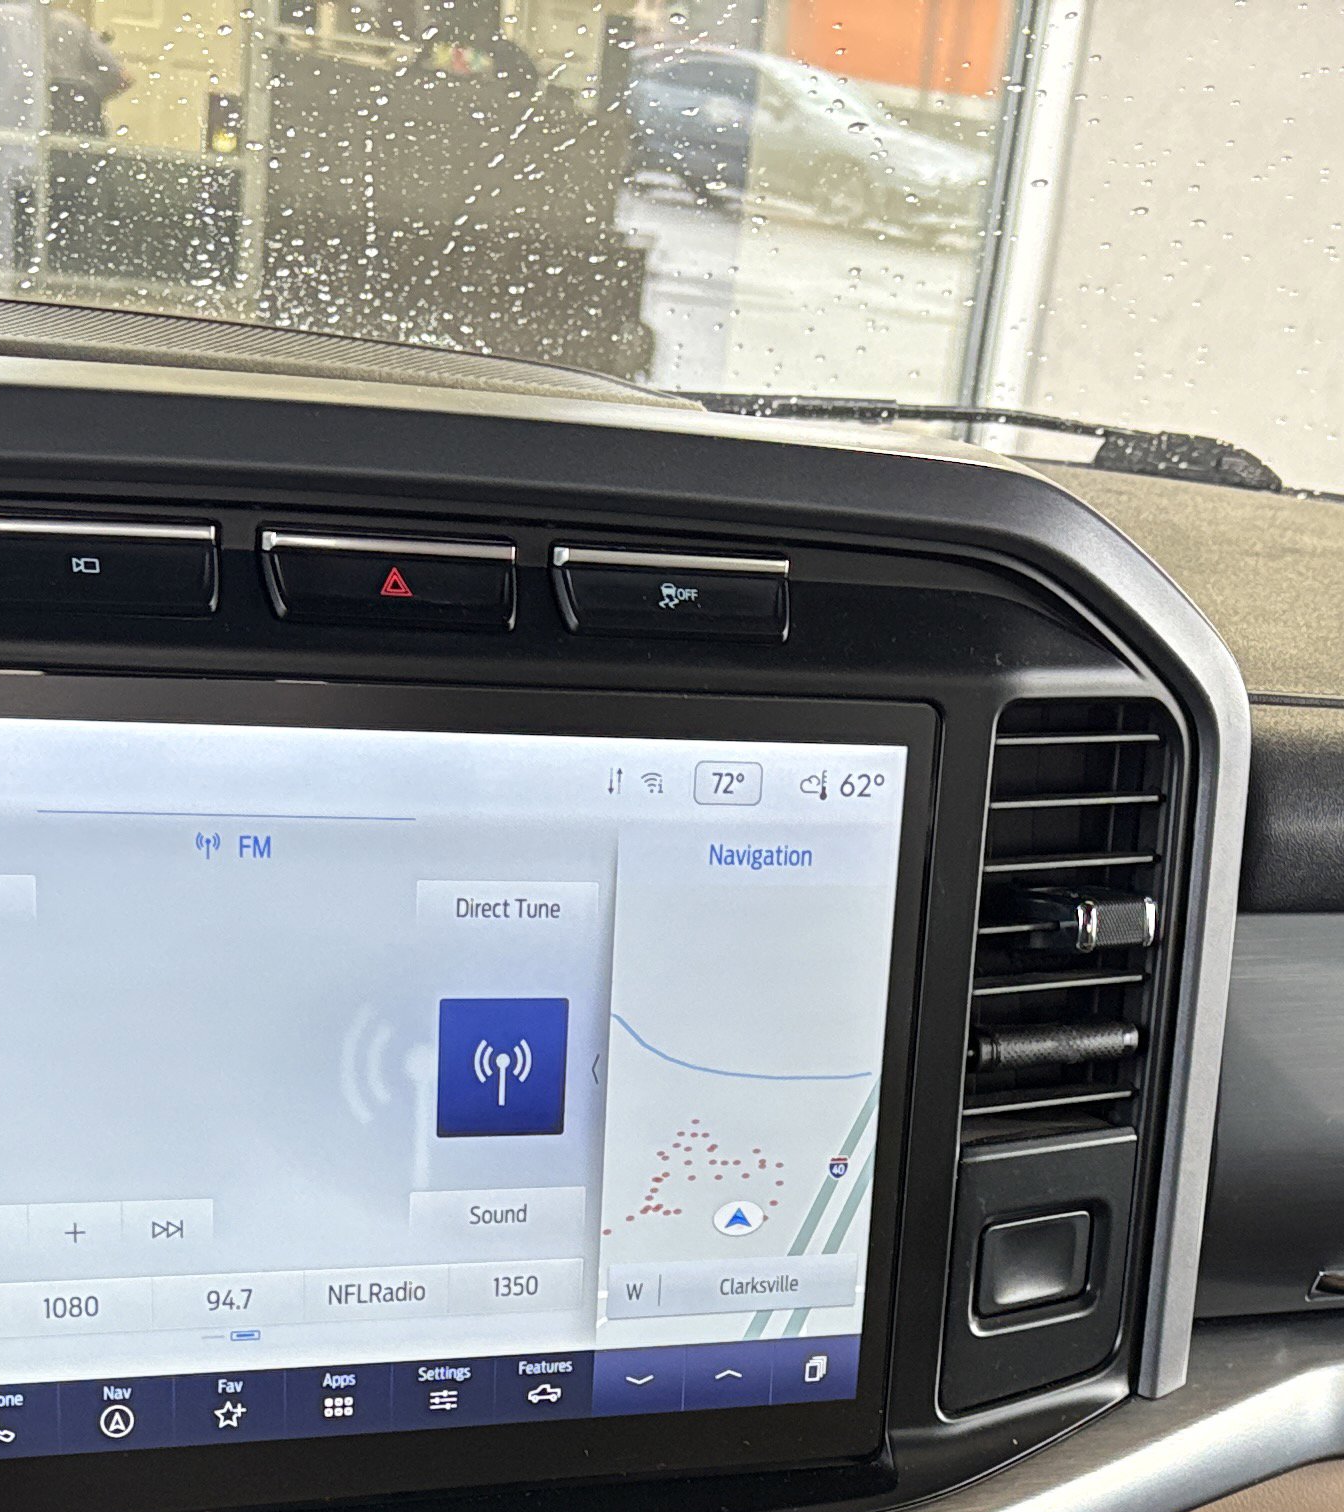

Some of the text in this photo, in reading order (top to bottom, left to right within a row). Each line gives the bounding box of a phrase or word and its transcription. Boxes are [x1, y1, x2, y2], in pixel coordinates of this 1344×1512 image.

[676, 587, 701, 602] OFF
[712, 772, 885, 798] 72° 62°
[239, 835, 272, 859] FM
[709, 843, 813, 871] Navigation
[456, 897, 561, 919] Direct Tune
[831, 1163, 847, 1176] 40
[469, 1203, 528, 1225] Sound
[328, 1280, 426, 1306] NFLRadio
[493, 1275, 539, 1298] 1350
[626, 1283, 644, 1301] W
[719, 1274, 799, 1296] Clarksville
[43, 1295, 99, 1319] 1080
[206, 1288, 253, 1312] 94.7
[418, 1365, 472, 1382] Settings
[518, 1360, 573, 1375] Features
[217, 1378, 244, 1394] Fav
[322, 1372, 357, 1389] Apps
[103, 1385, 132, 1401] Nav
